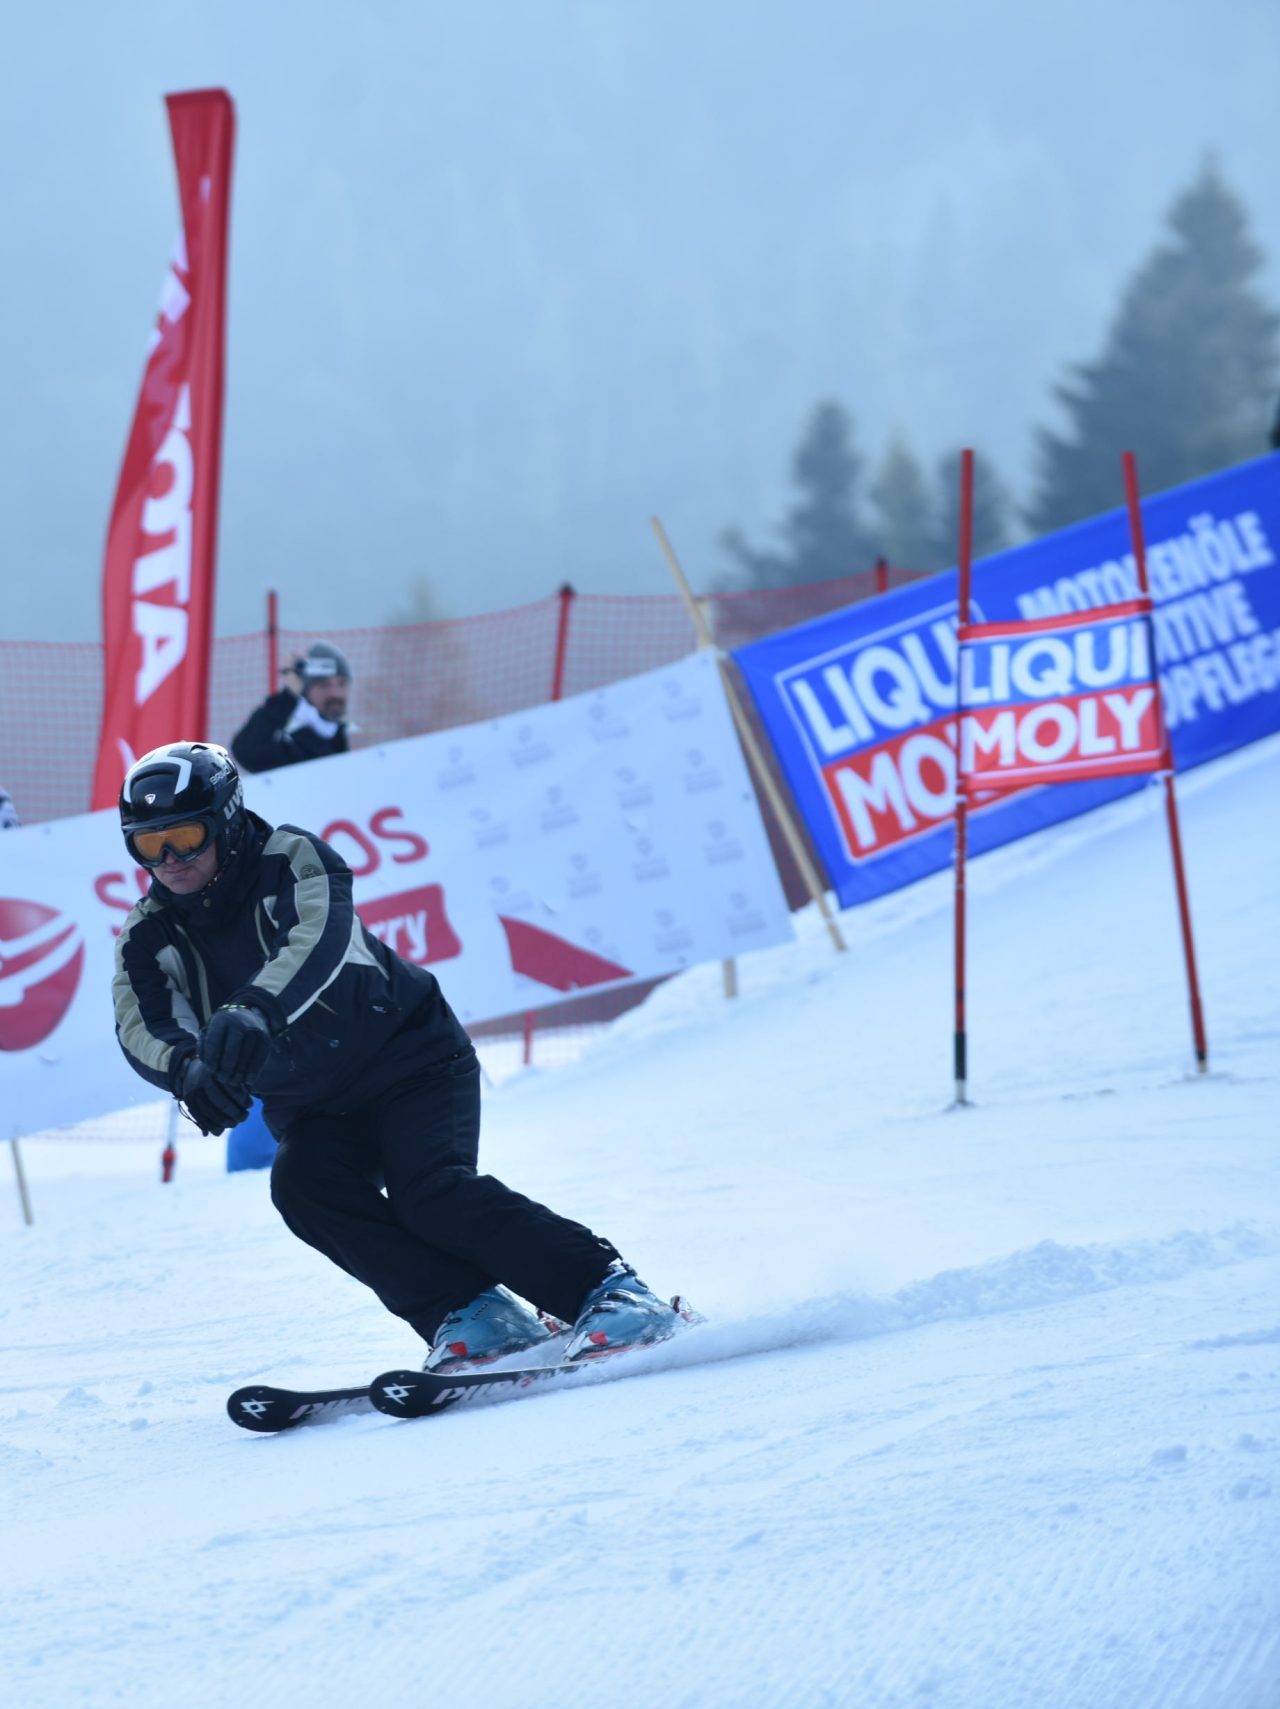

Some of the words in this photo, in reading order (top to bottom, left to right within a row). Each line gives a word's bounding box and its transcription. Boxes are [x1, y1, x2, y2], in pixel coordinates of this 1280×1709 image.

[790, 616, 959, 756] LIQU
[960, 619, 1149, 706] LIQUI
[960, 688, 1155, 774] MOLY
[834, 722, 959, 849] MO
